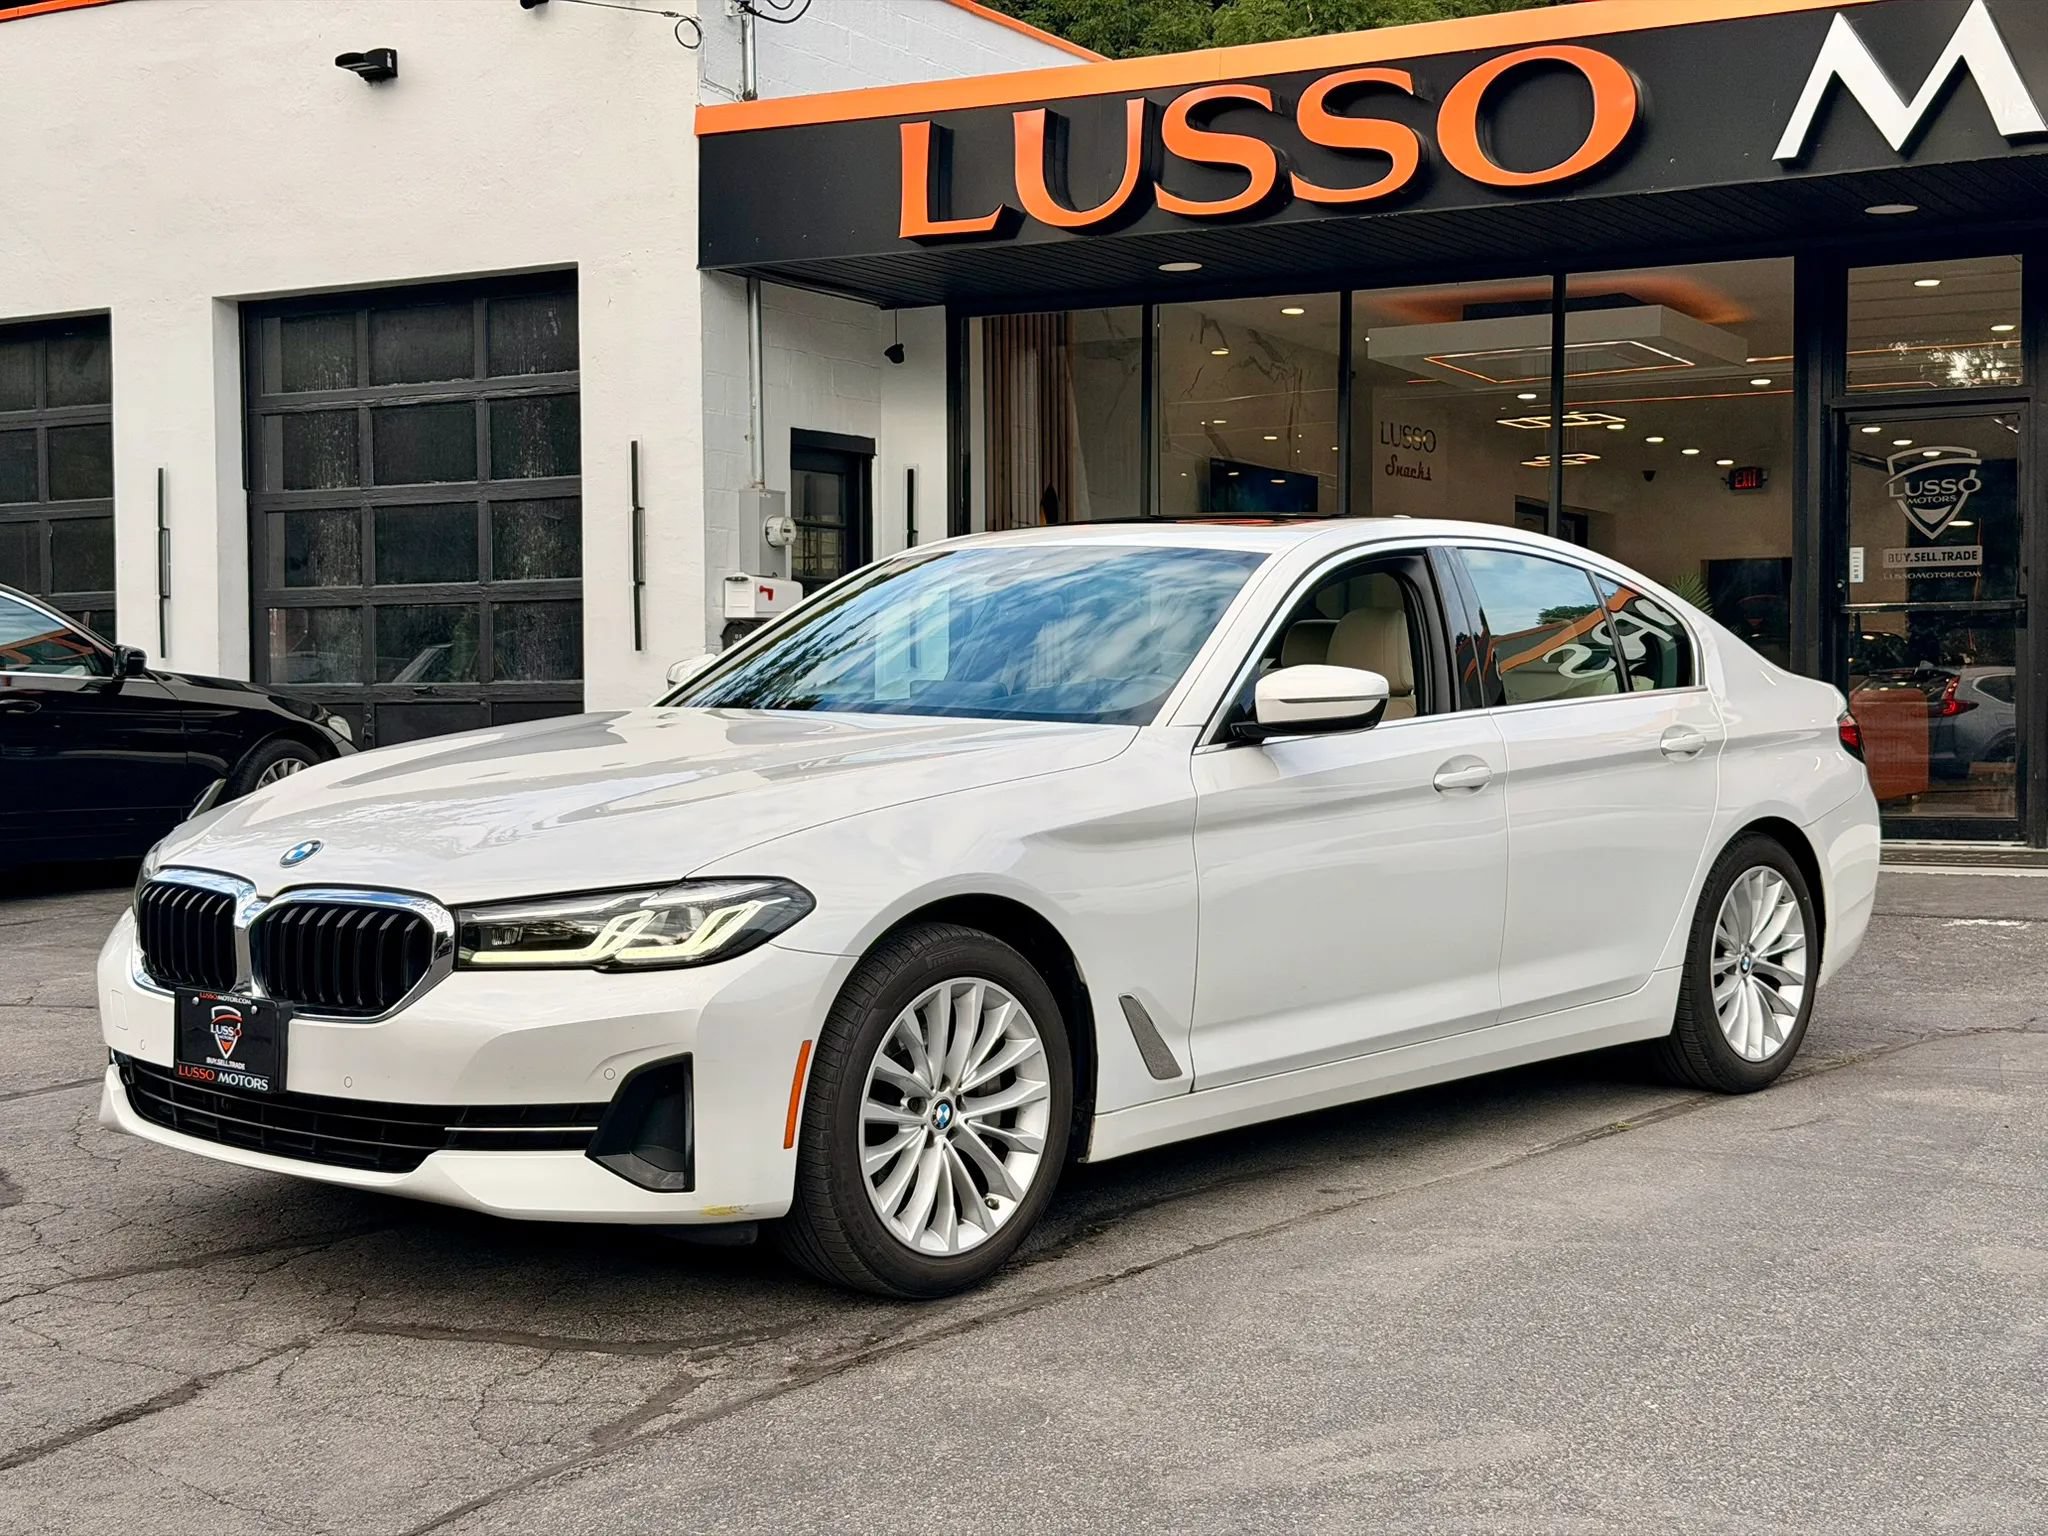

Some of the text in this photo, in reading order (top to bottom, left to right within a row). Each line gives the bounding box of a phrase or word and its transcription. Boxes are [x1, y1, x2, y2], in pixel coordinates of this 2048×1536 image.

[899, 0, 2048, 240] LUSSO M
[1380, 421, 1436, 453] LUSSO
[1385, 454, 1432, 481] Snacks
[1735, 469, 1756, 487] EXIT
[1889, 477, 1981, 498] LUSSO
[1906, 494, 1957, 505] MOTORS
[1888, 550, 1978, 563] BUY.SELL.TRADE
[211, 1024, 242, 1037] LUSSO
[178, 1065, 269, 1091] LUSSO MOTORS
